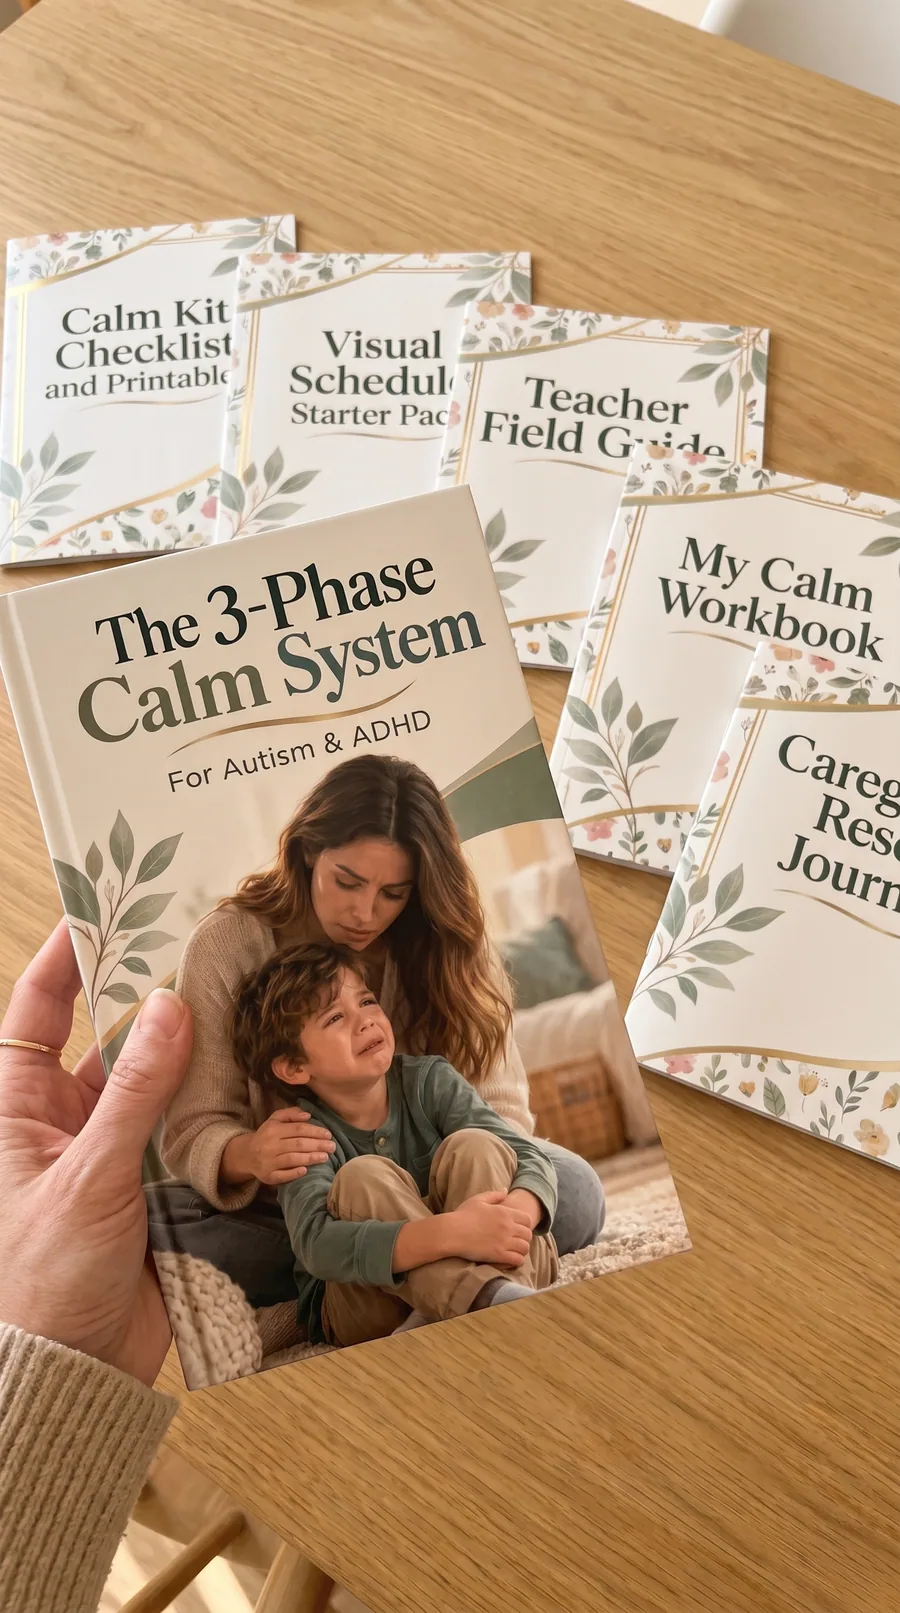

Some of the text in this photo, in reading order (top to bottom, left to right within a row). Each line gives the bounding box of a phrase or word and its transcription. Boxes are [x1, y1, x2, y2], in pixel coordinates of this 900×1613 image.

[61, 298, 230, 335] Calm Kit
[55, 332, 232, 370] Checklist
[322, 329, 442, 360] Visual
[45, 375, 98, 400] and
[289, 365, 455, 396] Schedul
[525, 376, 690, 425] Teacher
[291, 403, 391, 425] Starter
[479, 411, 583, 454] Field
[679, 537, 874, 614] My Calm
[95, 556, 437, 665] The 3-Phase
[658, 576, 885, 662] Workbook
[78, 610, 486, 743] Calm System
[168, 709, 432, 793] For Autism & ADHD
